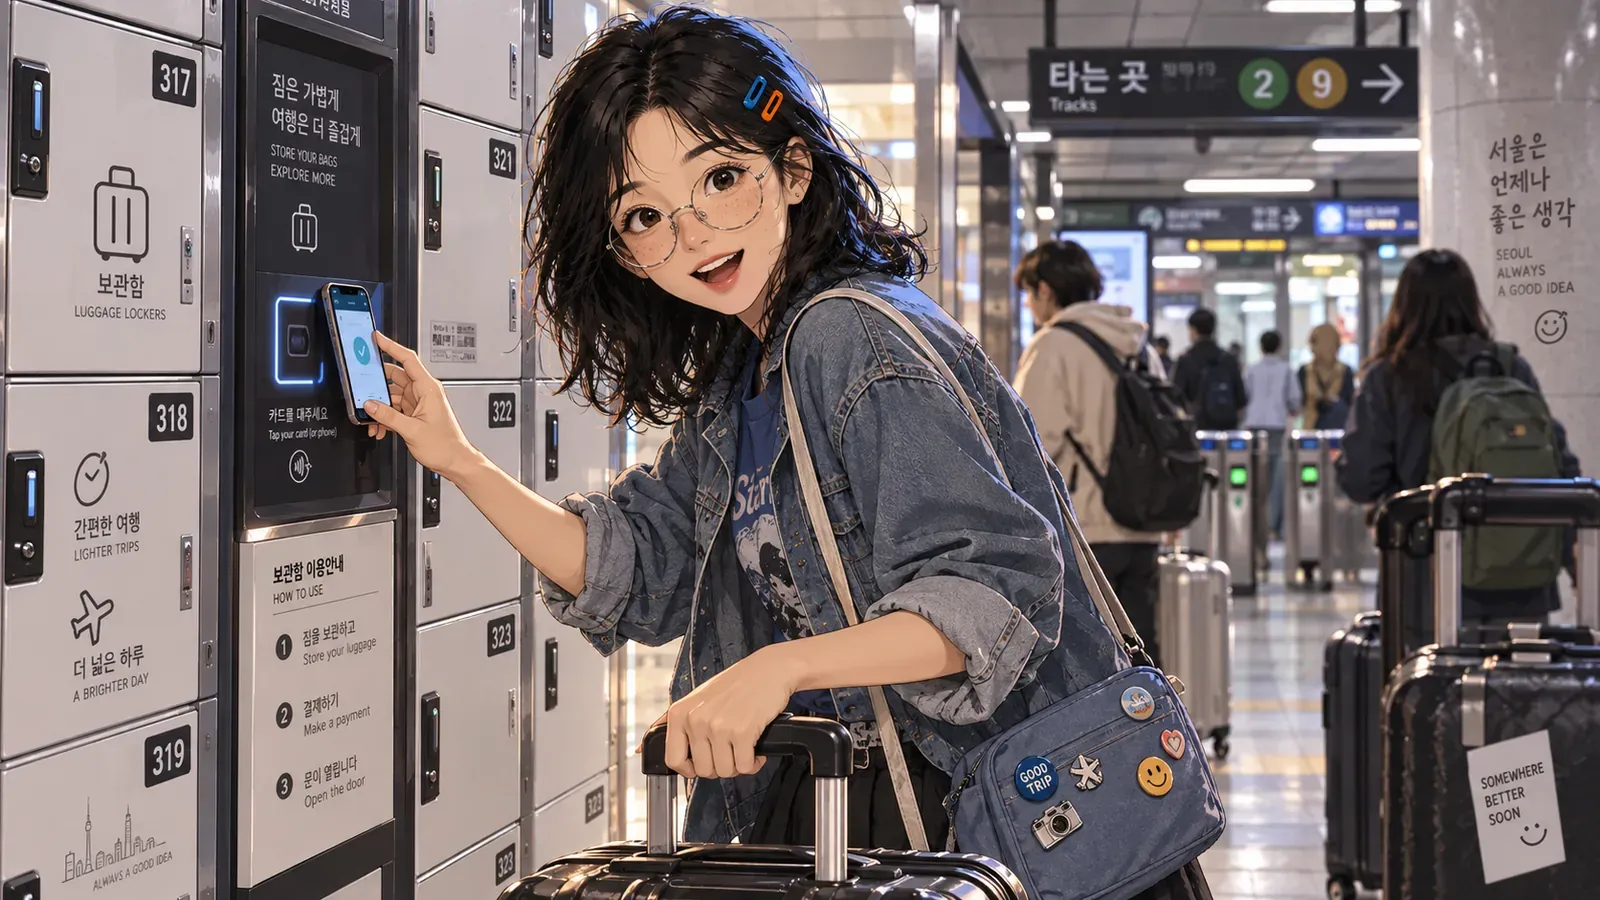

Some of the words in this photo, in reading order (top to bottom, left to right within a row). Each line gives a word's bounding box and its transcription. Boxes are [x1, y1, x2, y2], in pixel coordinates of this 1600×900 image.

[160, 63, 191, 96] 317
[1049, 60, 1110, 94] 타는
[1118, 60, 1149, 94] 곳
[1253, 68, 1275, 99] 2
[1312, 69, 1332, 98] 9
[272, 73, 299, 102] 짐은
[303, 82, 339, 112] 가볍게
[1050, 97, 1098, 113] Tracks
[272, 107, 309, 136] 여행은
[313, 117, 324, 140] 더
[328, 120, 361, 148] 즐겁게
[270, 143, 296, 160] STORE
[298, 149, 317, 164] YOUR
[319, 153, 338, 168] BAGS
[493, 146, 512, 173] 321
[1489, 132, 1547, 163] 서울은
[270, 163, 310, 182] EXPLORE
[312, 171, 336, 187] MORE
[1490, 166, 1550, 197] 언제나
[1489, 203, 1526, 235] 좋은
[1532, 197, 1576, 229] 생각
[1496, 246, 1533, 261] SEOUL
[1497, 264, 1546, 279] ALWAYS
[97, 273, 144, 299] 보관함
[1498, 285, 1506, 296] A
[1509, 283, 1542, 296] GOOD
[1546, 281, 1575, 294] IDEA
[74, 305, 122, 319] LUGGAGE
[124, 308, 166, 321] LOCKERS
[156, 403, 188, 432] 318
[492, 402, 512, 426] 322
[269, 430, 280, 441] Tap
[281, 432, 294, 441] your
[295, 428, 309, 439] card
[74, 514, 113, 541] 간편한
[116, 510, 141, 535] 여행
[74, 544, 113, 562] LIGHTER
[115, 540, 140, 555] TRIPS
[273, 561, 303, 584] 보관함
[306, 554, 344, 579] 이용안내
[273, 590, 294, 605] HOW
[296, 587, 307, 600] TO
[308, 583, 324, 598] USE
[280, 639, 287, 656] 1
[303, 627, 320, 648] 짐을
[323, 620, 356, 641] 보관하고
[492, 622, 512, 650] 323
[73, 657, 86, 680] 더
[91, 651, 116, 677] 넓은
[120, 644, 144, 669] 하루
[303, 652, 325, 666] Store
[326, 646, 345, 662] your
[346, 637, 377, 654] luggage
[73, 690, 81, 703] A
[83, 677, 129, 701] BRIGHTER
[131, 671, 149, 689] DAY
[280, 707, 288, 724] 2
[303, 692, 339, 719] 결제하기
[303, 720, 327, 737] Make
[328, 718, 334, 729] a
[336, 706, 371, 729] payment
[152, 738, 185, 776] 319
[281, 777, 289, 795] 3
[303, 767, 322, 790] 문이
[324, 755, 358, 783] 열립니다
[1020, 763, 1048, 783] GOOD
[1026, 775, 1052, 794] TRIP
[1481, 762, 1544, 789] SOMEWHERE
[304, 790, 328, 809] Open
[330, 784, 344, 798] the
[346, 775, 366, 792] door
[1485, 786, 1526, 808] BETTER
[1488, 806, 1521, 826] SOON
[125, 867, 131, 879] A
[132, 857, 155, 875] GOOD
[156, 850, 173, 866] IDEA
[497, 851, 514, 878] 323
